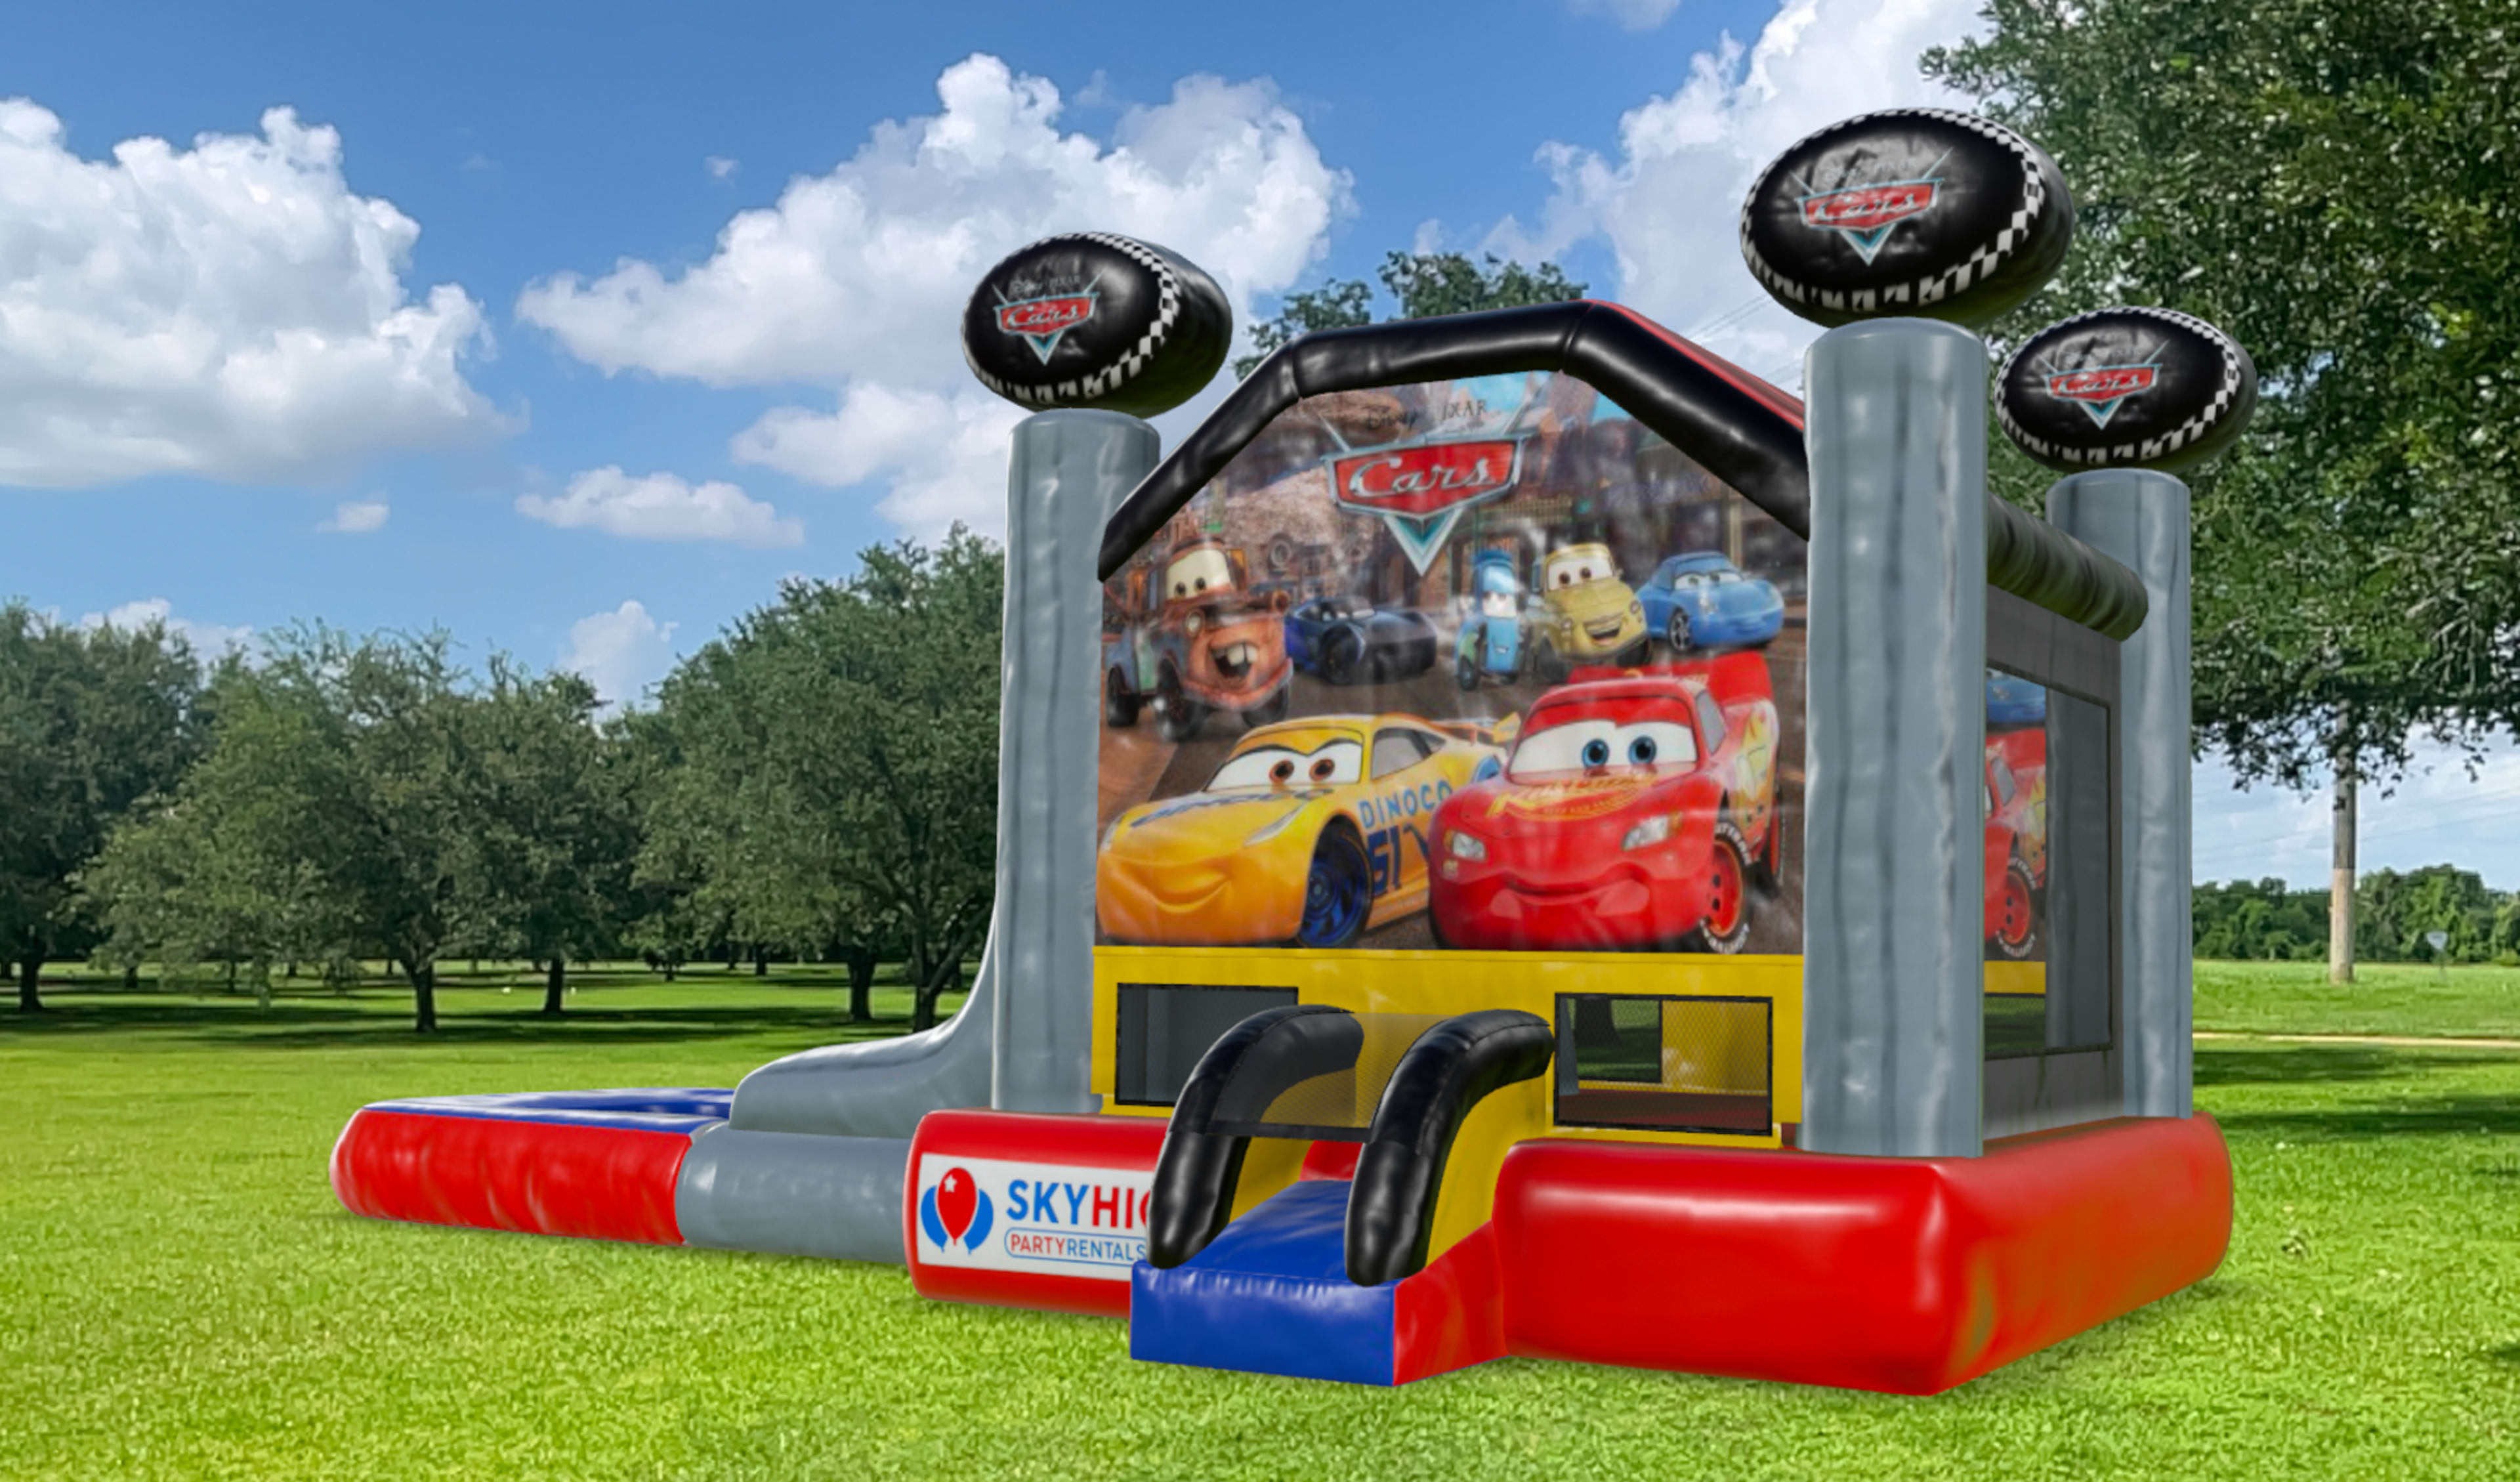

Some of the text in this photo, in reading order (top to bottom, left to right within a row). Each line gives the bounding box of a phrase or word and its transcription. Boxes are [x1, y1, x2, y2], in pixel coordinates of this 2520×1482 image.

[1814, 193, 1919, 221] Cars
[1007, 304, 1080, 326] Cars
[2058, 374, 2142, 394] Cars
[1349, 457, 1496, 498] Cars
[1358, 779, 1453, 829] DINOCO
[1011, 1234, 1146, 1261] PARTYRENTALS
